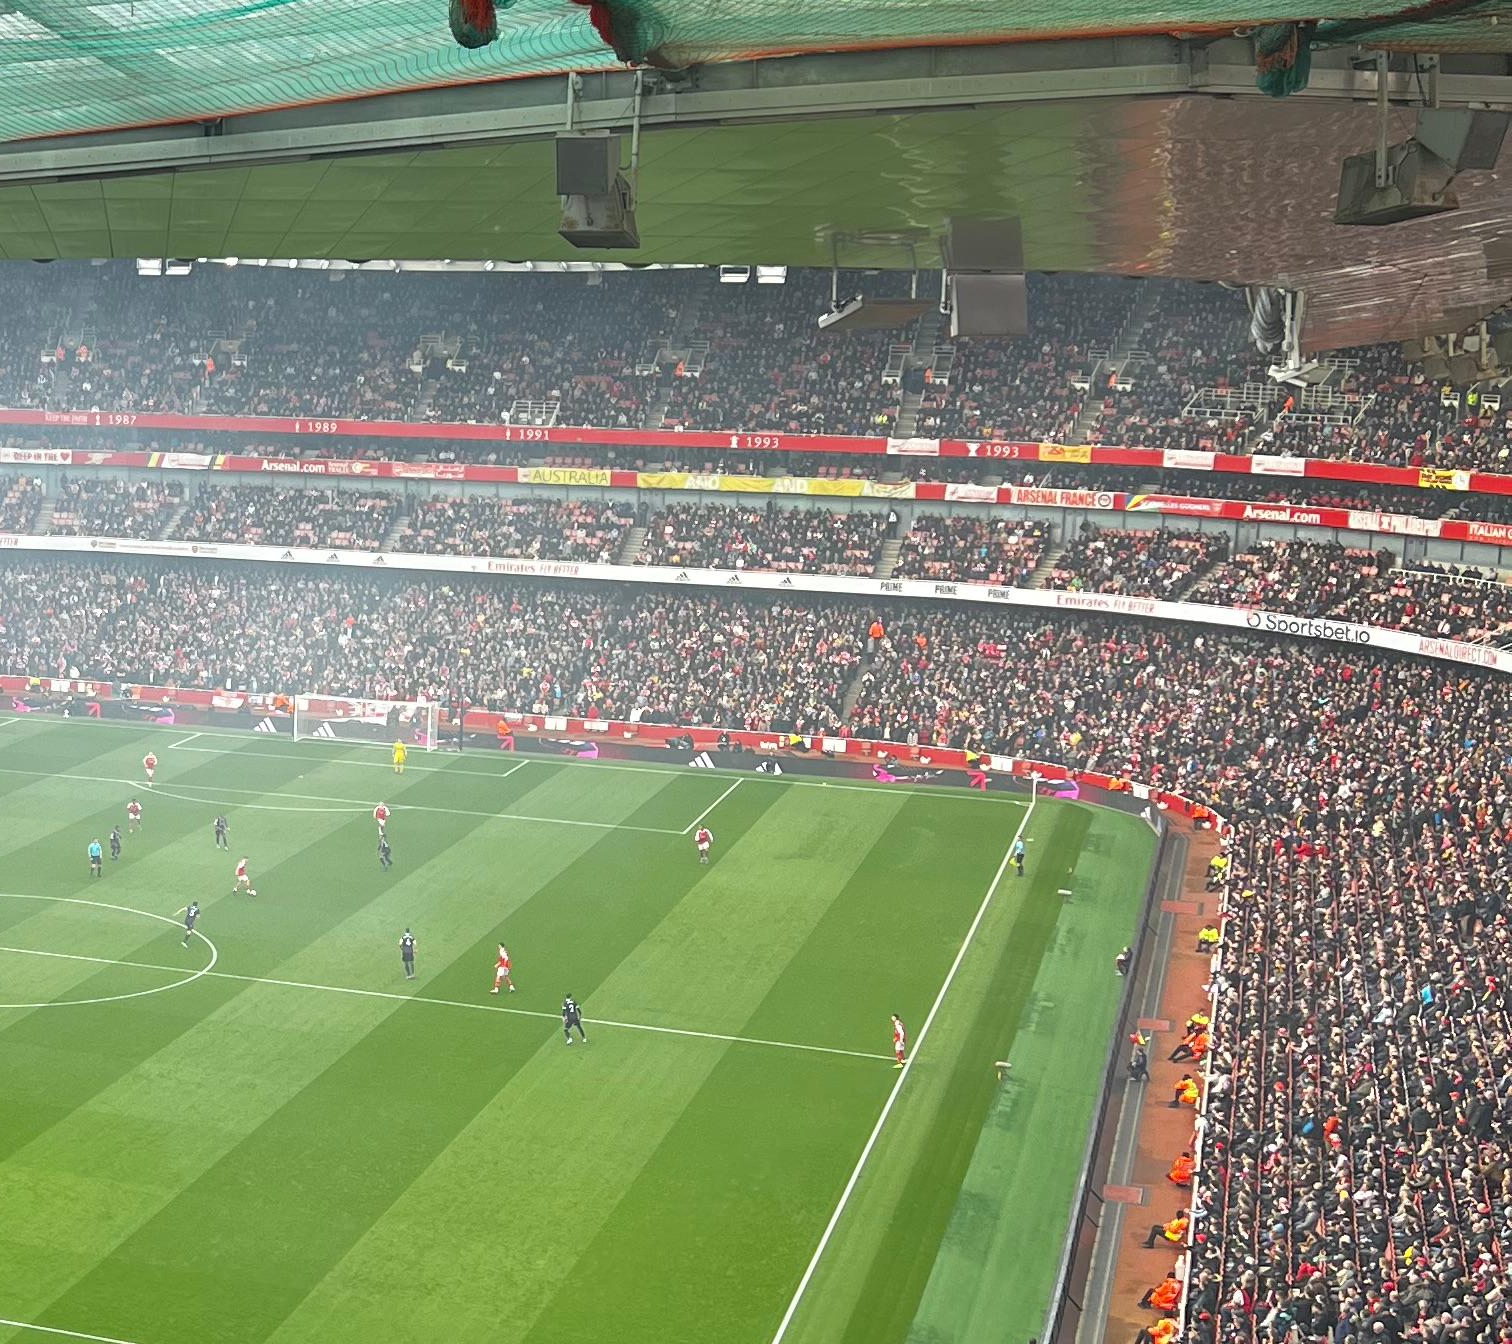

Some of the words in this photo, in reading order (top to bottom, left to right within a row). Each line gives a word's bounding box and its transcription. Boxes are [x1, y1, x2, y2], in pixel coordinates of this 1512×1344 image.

[108, 414, 137, 425] 1987
[307, 422, 337, 433] 1989
[519, 429, 550, 441] 1991
[746, 436, 780, 449] 1993
[986, 444, 1019, 458] 1993
[261, 459, 326, 473] Arsenal.com
[532, 469, 608, 485] AUSTRALIA
[1017, 489, 1058, 505] ARSENAL
[1060, 491, 1096, 507] FRANCE
[1242, 504, 1321, 525] Arsenal.com
[1469, 523, 1506, 538] ITALIAN
[488, 560, 536, 574] Emirates
[880, 581, 903, 593] PRIME
[935, 584, 957, 596] PRIME
[988, 588, 1010, 600] PRIME
[1057, 594, 1109, 609] Emirates
[1266, 614, 1371, 644] Sportsbet.io
